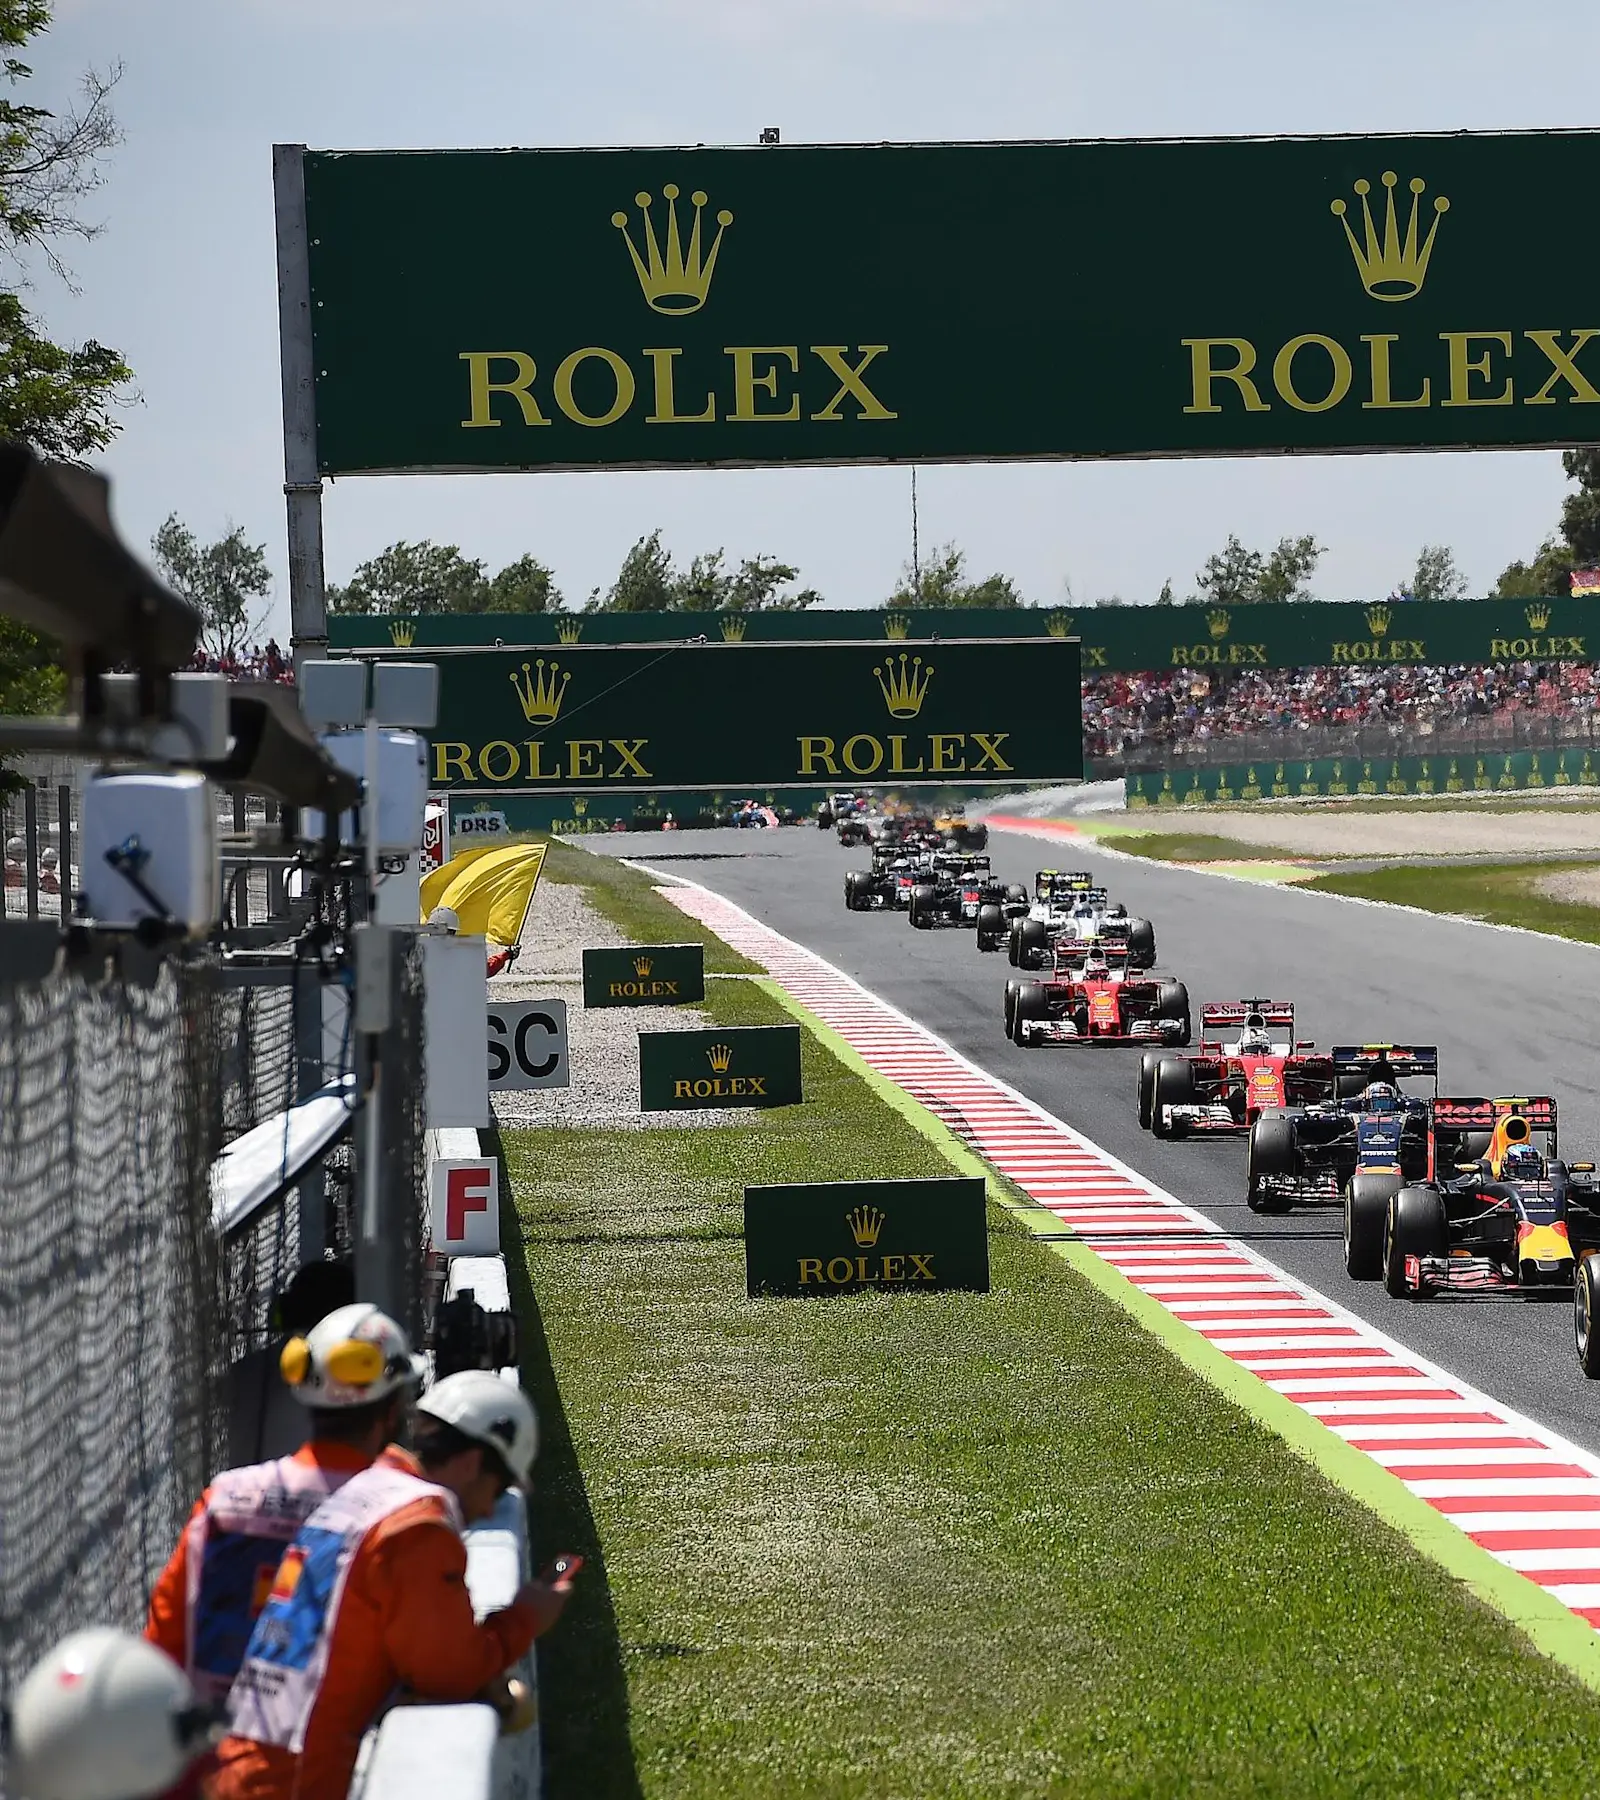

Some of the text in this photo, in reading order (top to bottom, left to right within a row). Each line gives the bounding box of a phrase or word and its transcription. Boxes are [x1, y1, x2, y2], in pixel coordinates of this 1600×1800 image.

[461, 345, 897, 427] ROLEX
[1171, 644, 1267, 665] ROLEX
[1332, 639, 1425, 661] ROLEX
[1491, 636, 1586, 659] ROLEX
[432, 739, 652, 782] ROLEX
[797, 733, 1013, 775] ROLEX
[461, 817, 500, 833] DRS
[609, 981, 679, 997] ROLEX
[674, 1076, 767, 1099] ROLEX
[446, 1168, 490, 1240] F
[798, 1254, 936, 1285] ROLEX
